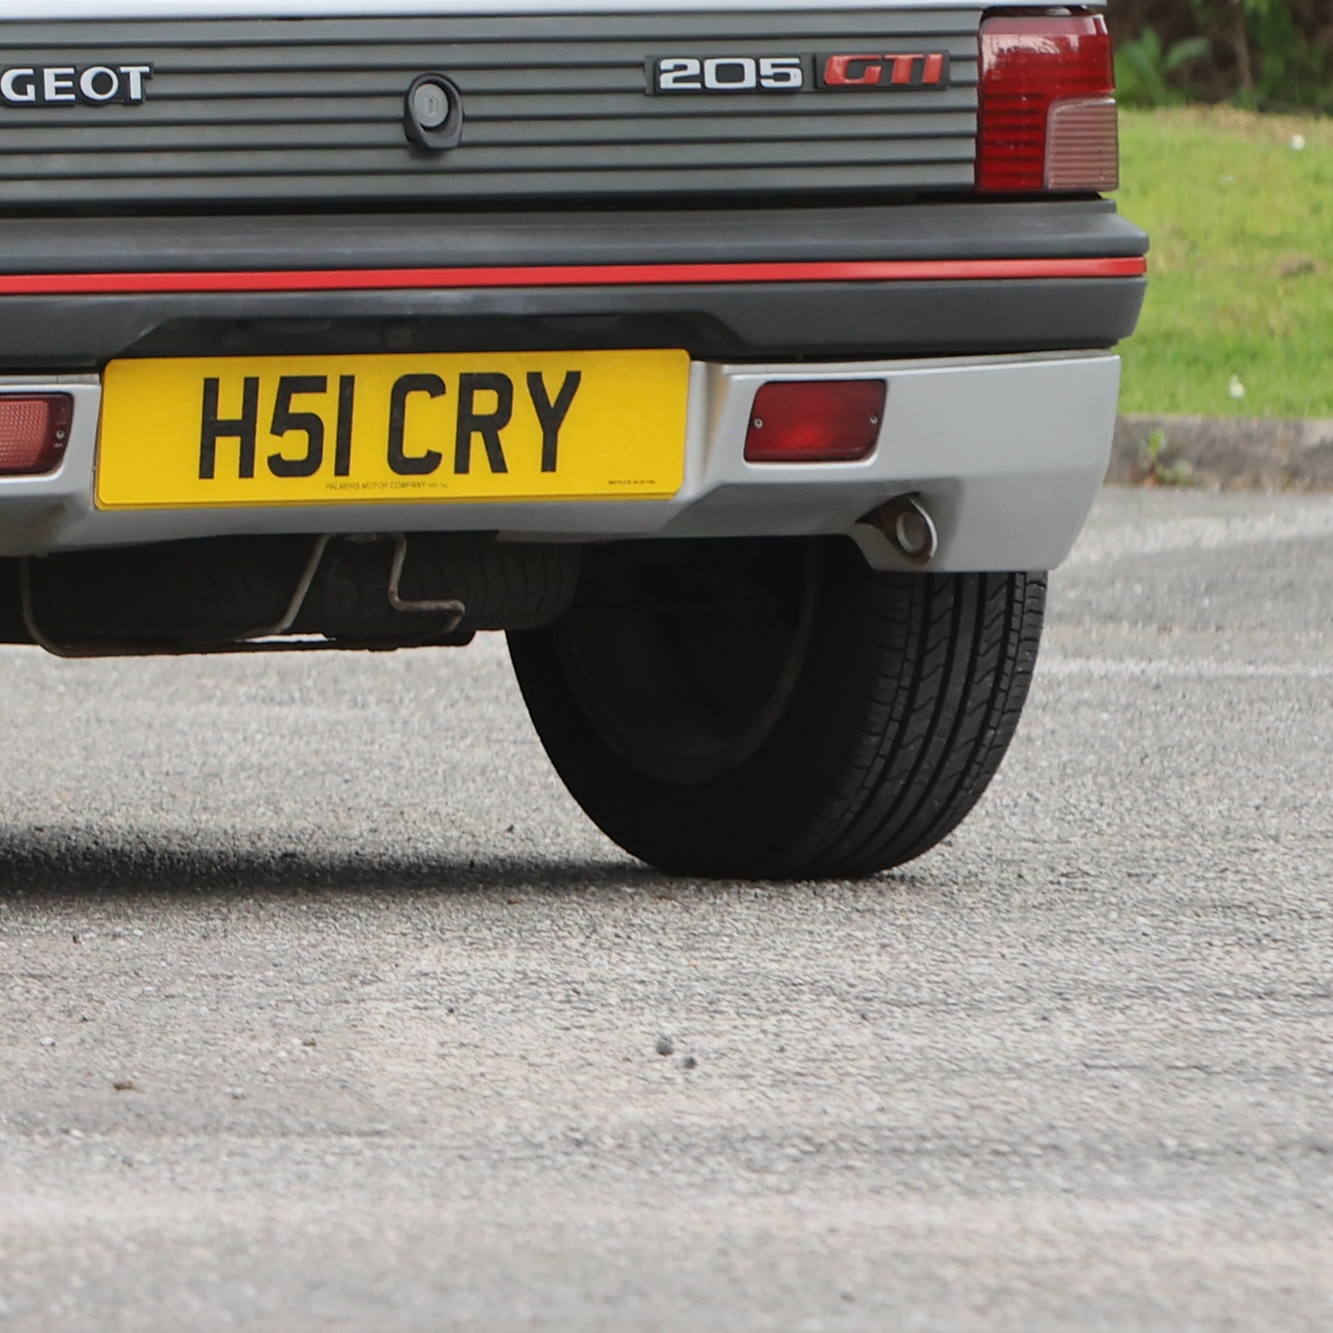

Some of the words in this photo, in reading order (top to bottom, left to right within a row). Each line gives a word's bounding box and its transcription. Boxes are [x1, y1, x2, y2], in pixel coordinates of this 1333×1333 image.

[659, 58, 802, 89] 205
[824, 53, 944, 86] GTI
[197, 374, 355, 480] H51
[387, 369, 582, 475] CRY
